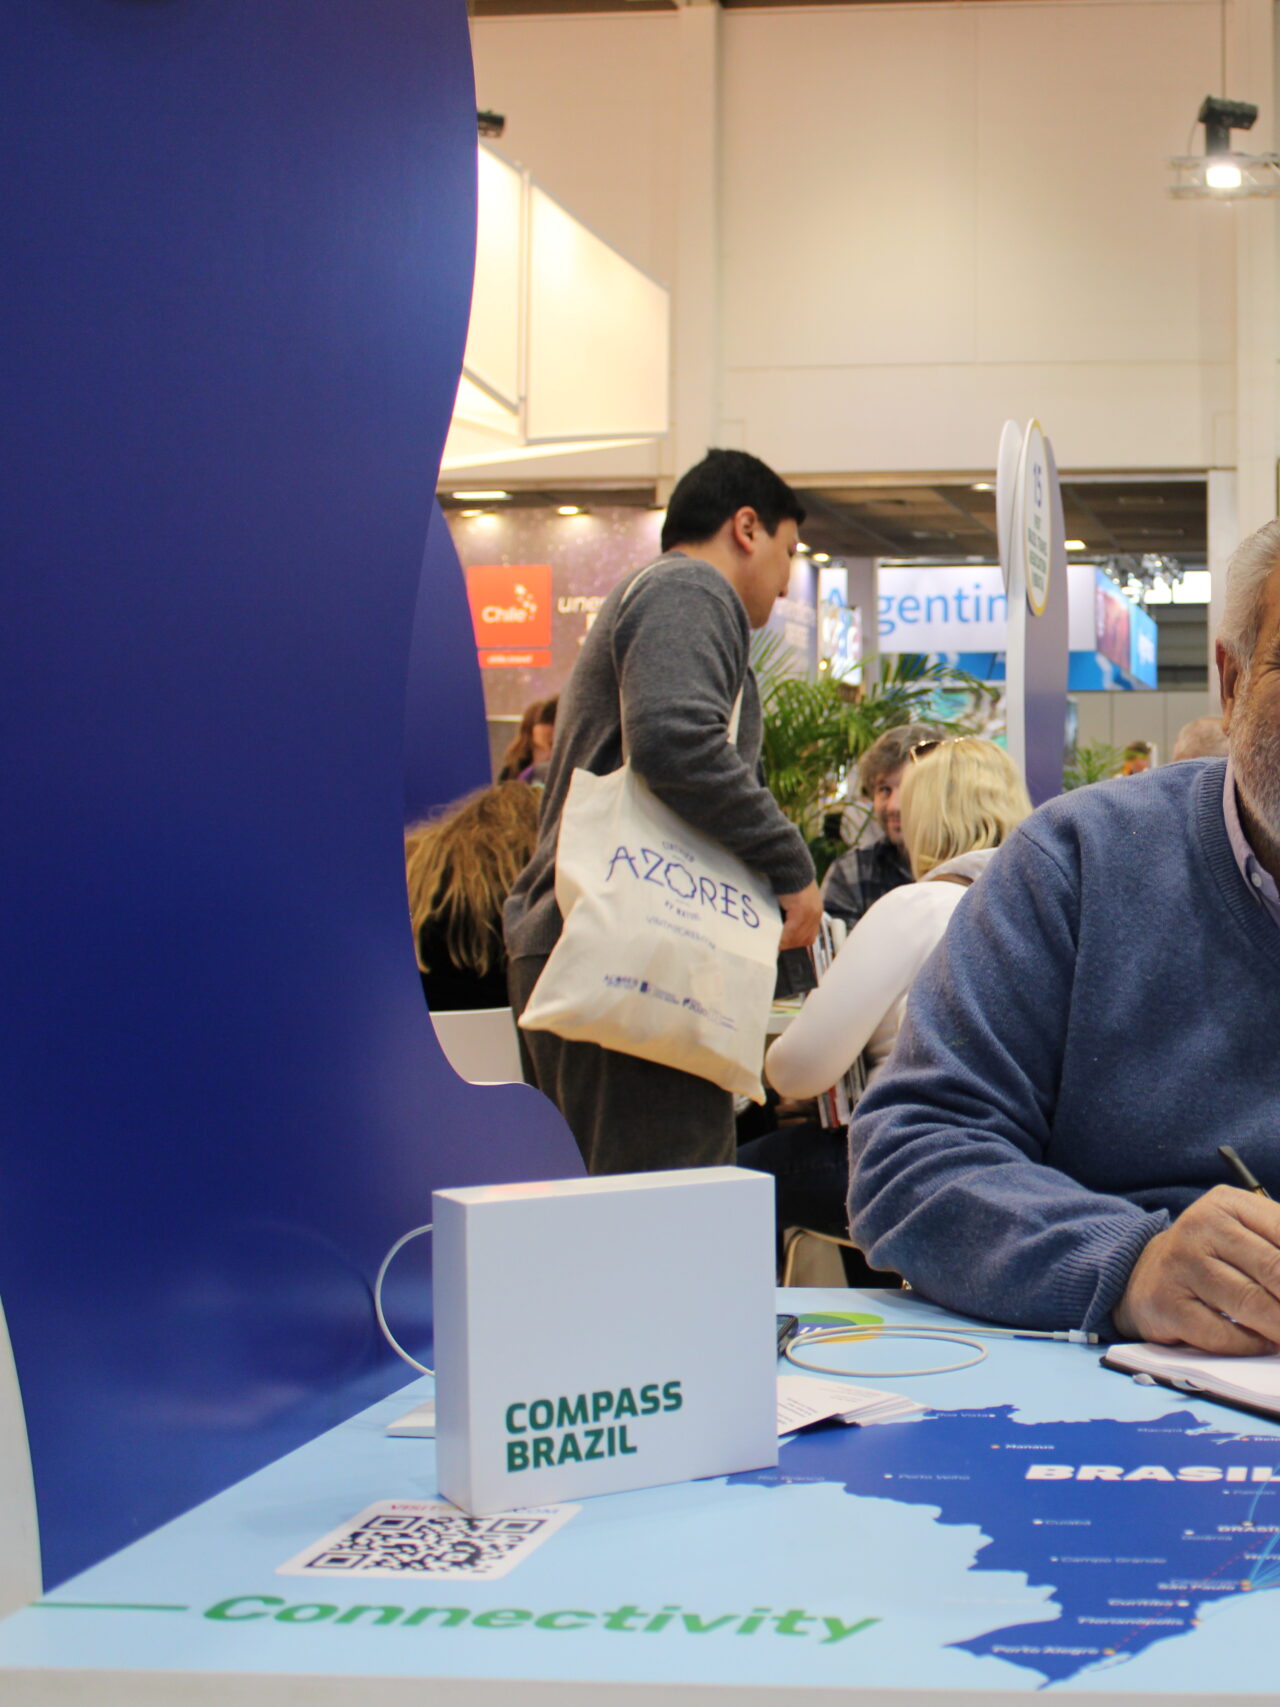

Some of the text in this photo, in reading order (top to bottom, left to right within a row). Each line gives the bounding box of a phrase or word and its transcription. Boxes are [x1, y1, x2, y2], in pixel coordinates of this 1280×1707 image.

[481, 605, 527, 624] Chile
[606, 846, 760, 928] AZORES
[505, 1380, 683, 1435] COMPASS
[506, 1424, 639, 1474] BRAZIL
[202, 1595, 884, 1644] Connectivity
